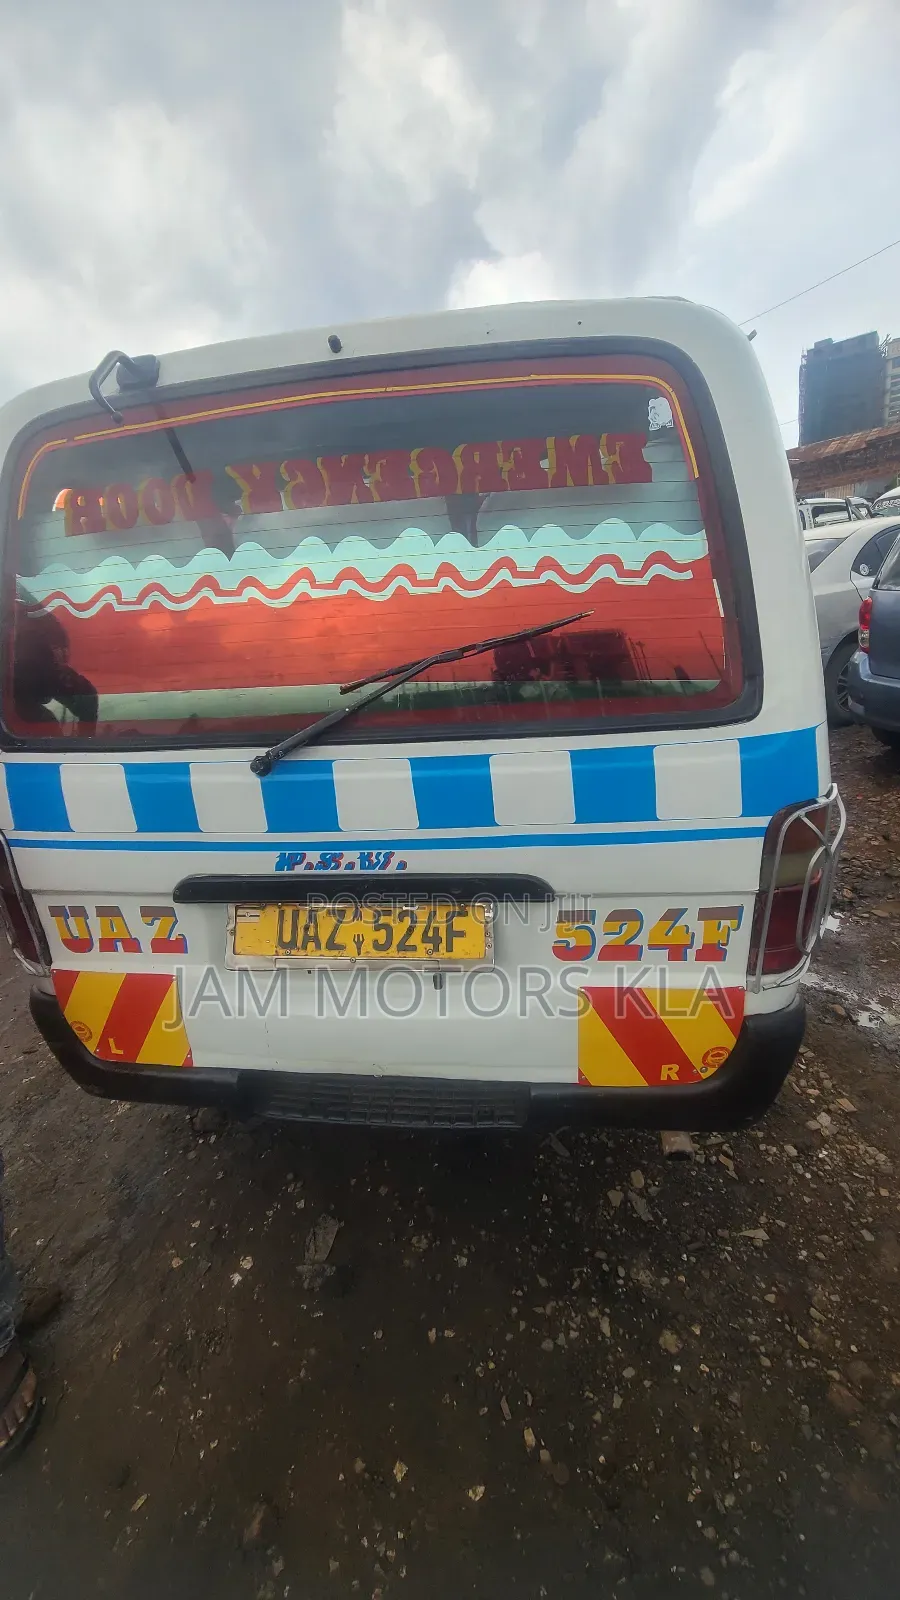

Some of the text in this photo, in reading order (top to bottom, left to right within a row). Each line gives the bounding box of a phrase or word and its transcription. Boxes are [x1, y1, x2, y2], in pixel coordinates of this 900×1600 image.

[48, 905, 188, 954] UAZ
[277, 908, 469, 953] UAZ 524F
[551, 905, 745, 961] 524F
[660, 1064, 679, 1081] R
